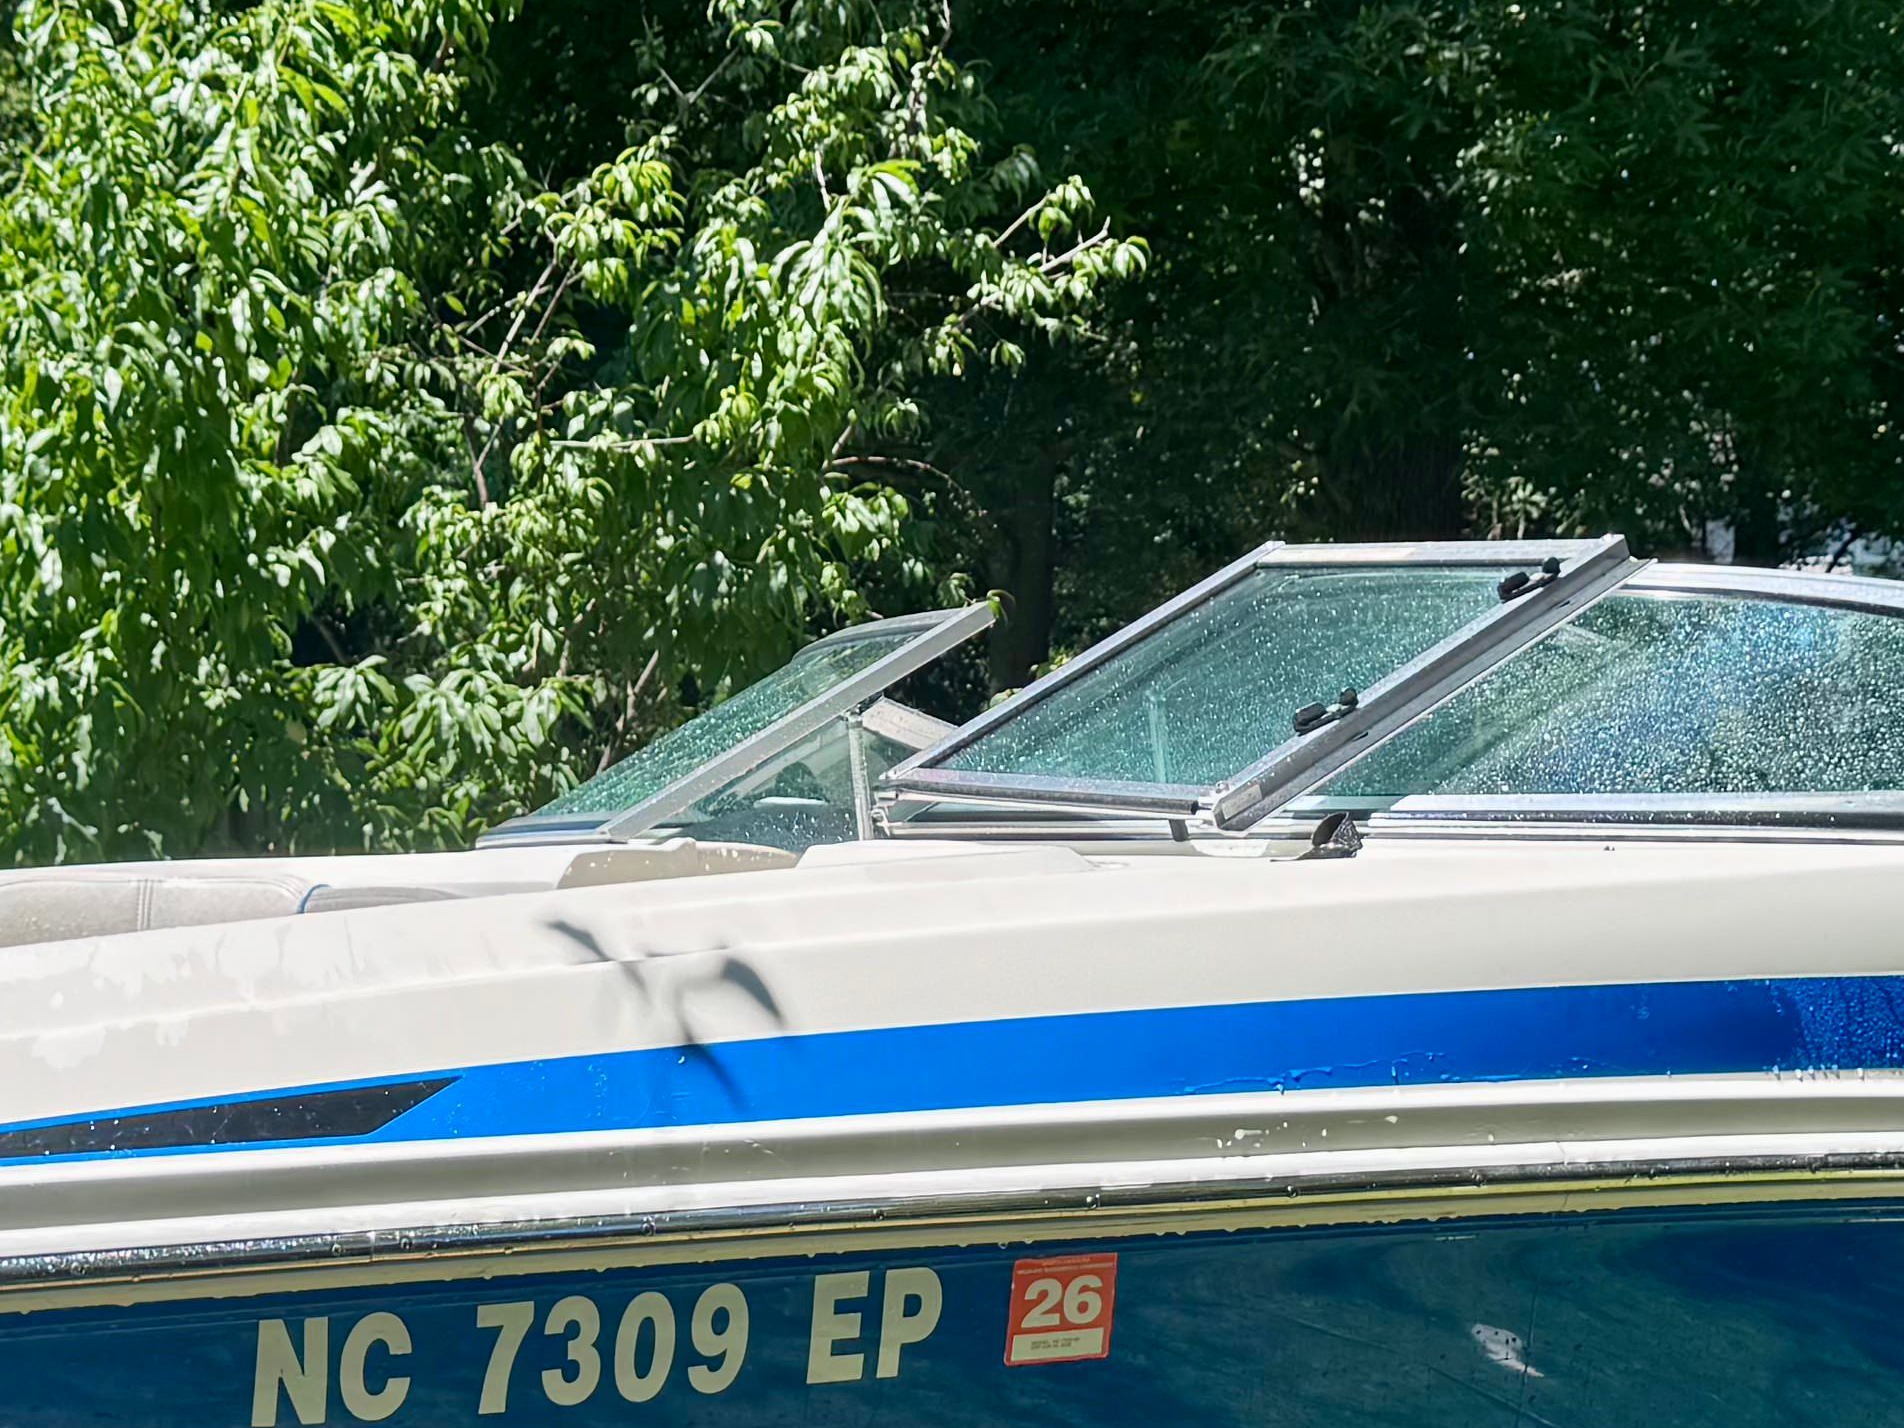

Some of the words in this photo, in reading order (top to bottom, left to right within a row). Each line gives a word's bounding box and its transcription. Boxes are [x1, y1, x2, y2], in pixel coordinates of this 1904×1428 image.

[251, 1311, 413, 1428] NC
[476, 1282, 749, 1415] 7309
[806, 1267, 943, 1384] EP
[1021, 1274, 1104, 1329] 26
